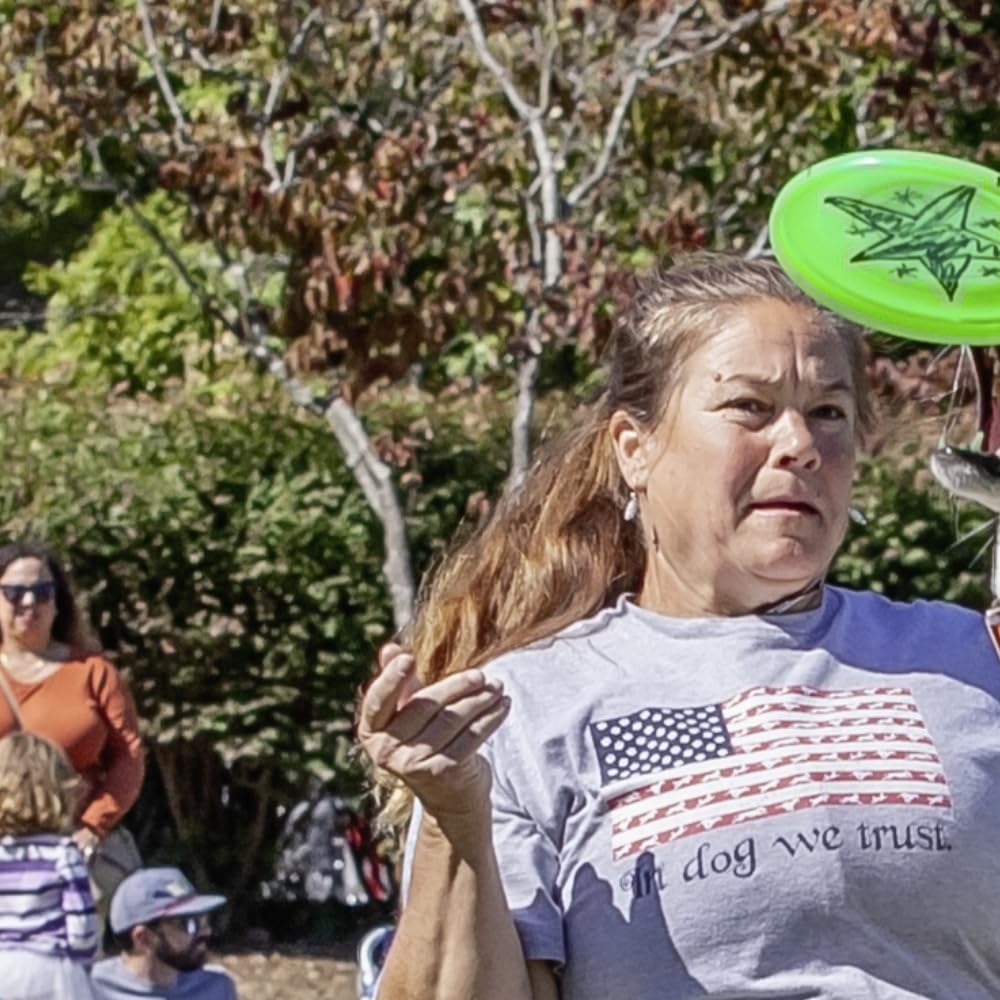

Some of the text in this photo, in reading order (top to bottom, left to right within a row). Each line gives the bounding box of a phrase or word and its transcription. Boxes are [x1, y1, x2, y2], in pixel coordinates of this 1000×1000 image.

[682, 837, 756, 881] dog
[772, 824, 844, 857] we
[857, 821, 952, 852] trust.
